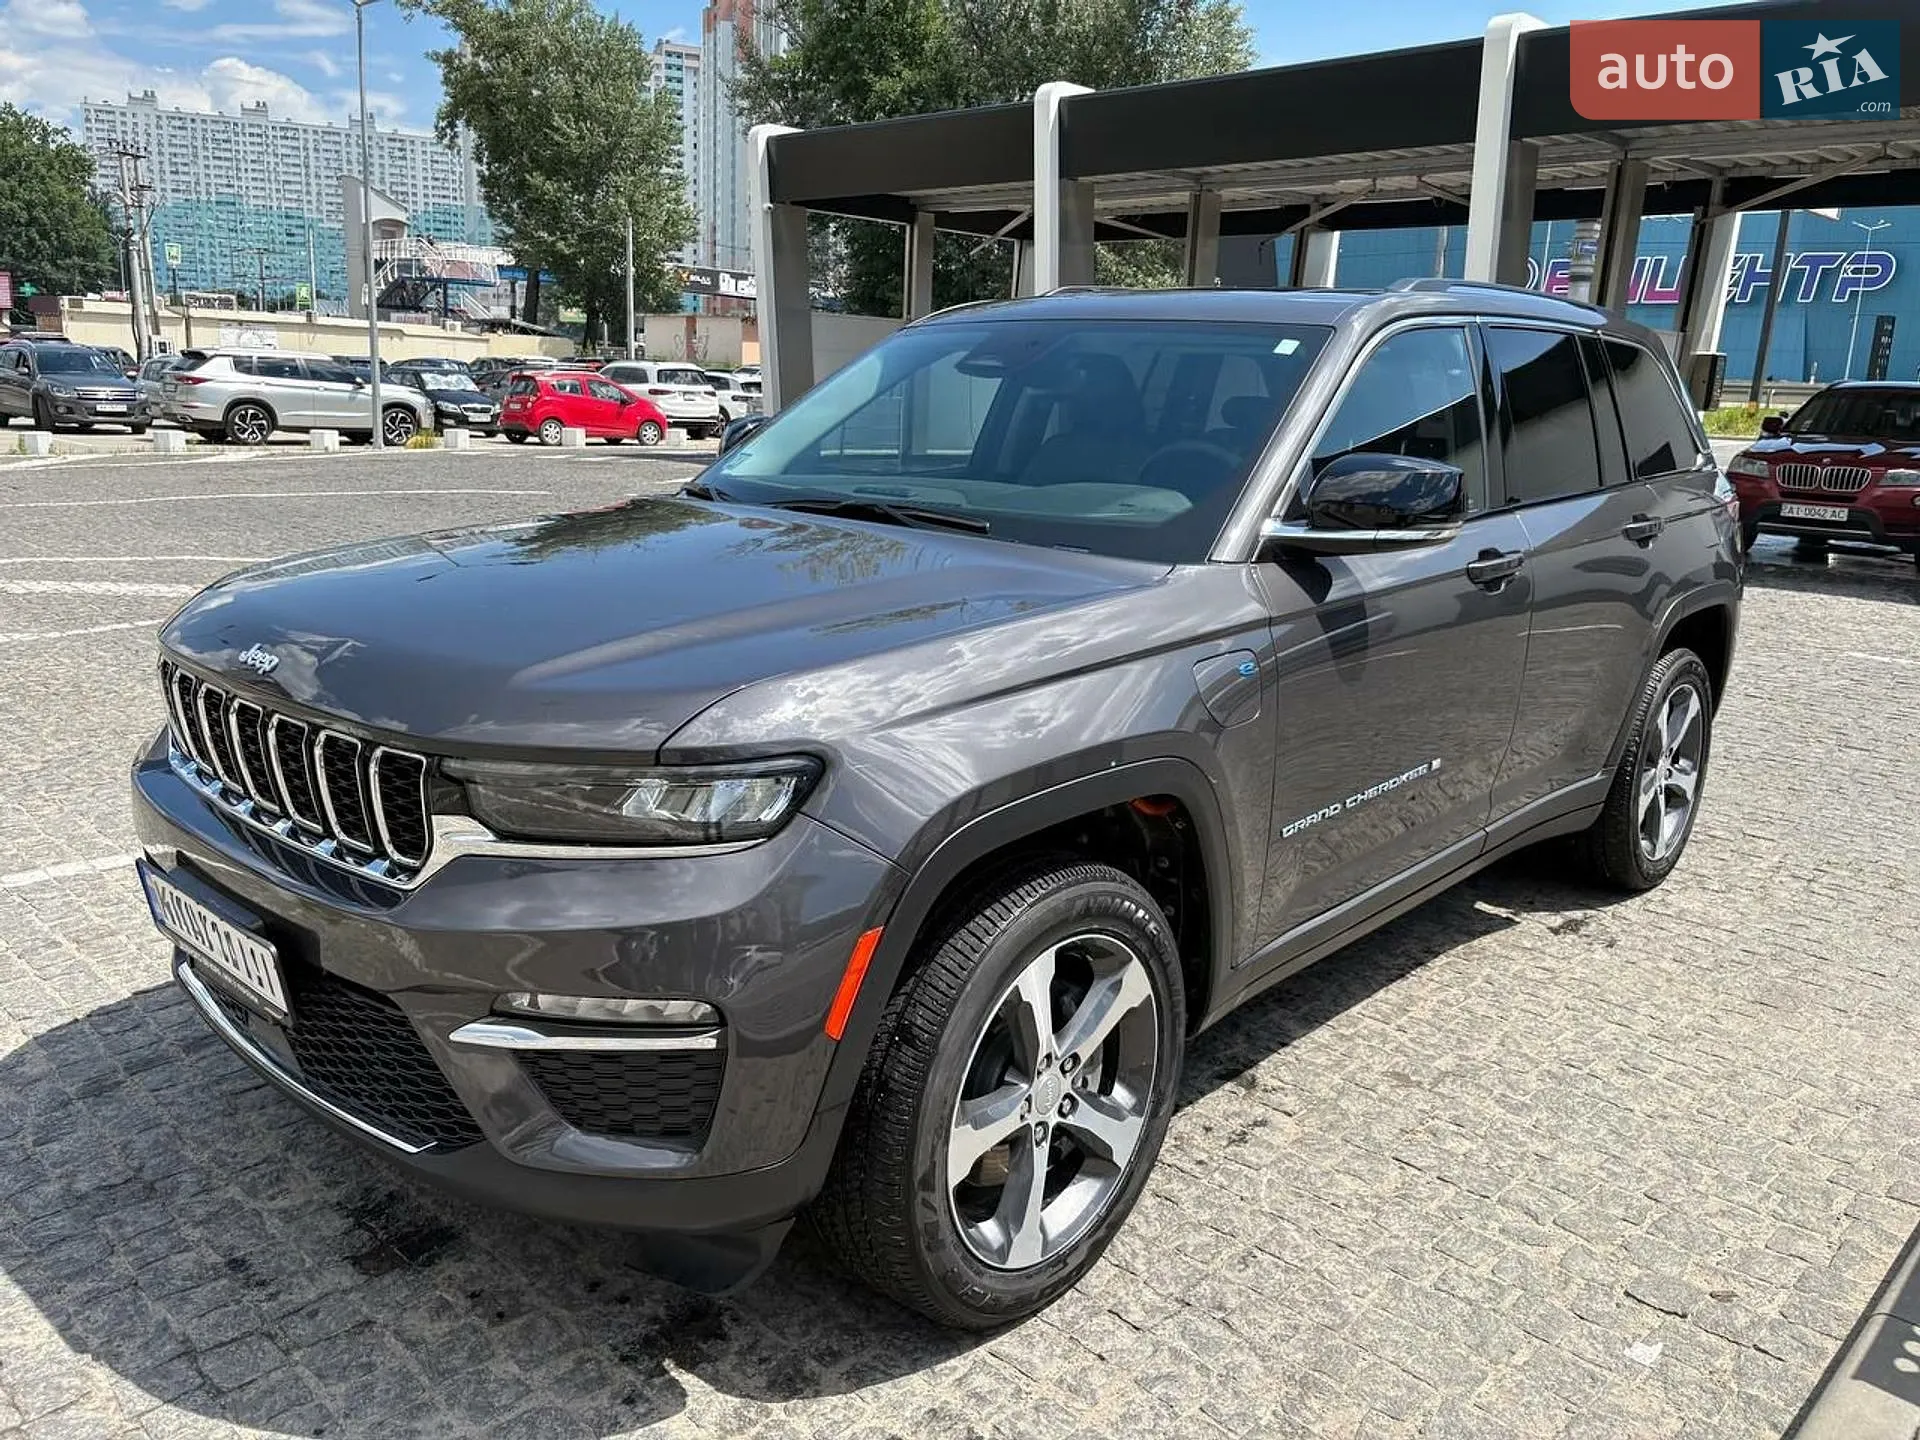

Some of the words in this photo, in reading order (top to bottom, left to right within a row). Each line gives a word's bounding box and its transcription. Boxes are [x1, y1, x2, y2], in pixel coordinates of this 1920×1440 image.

[1829, 509, 1846, 519] AC
[238, 643, 280, 675] Jeep
[1281, 802, 1342, 838] GRAND
[1344, 764, 1429, 809] CHEROKEE
